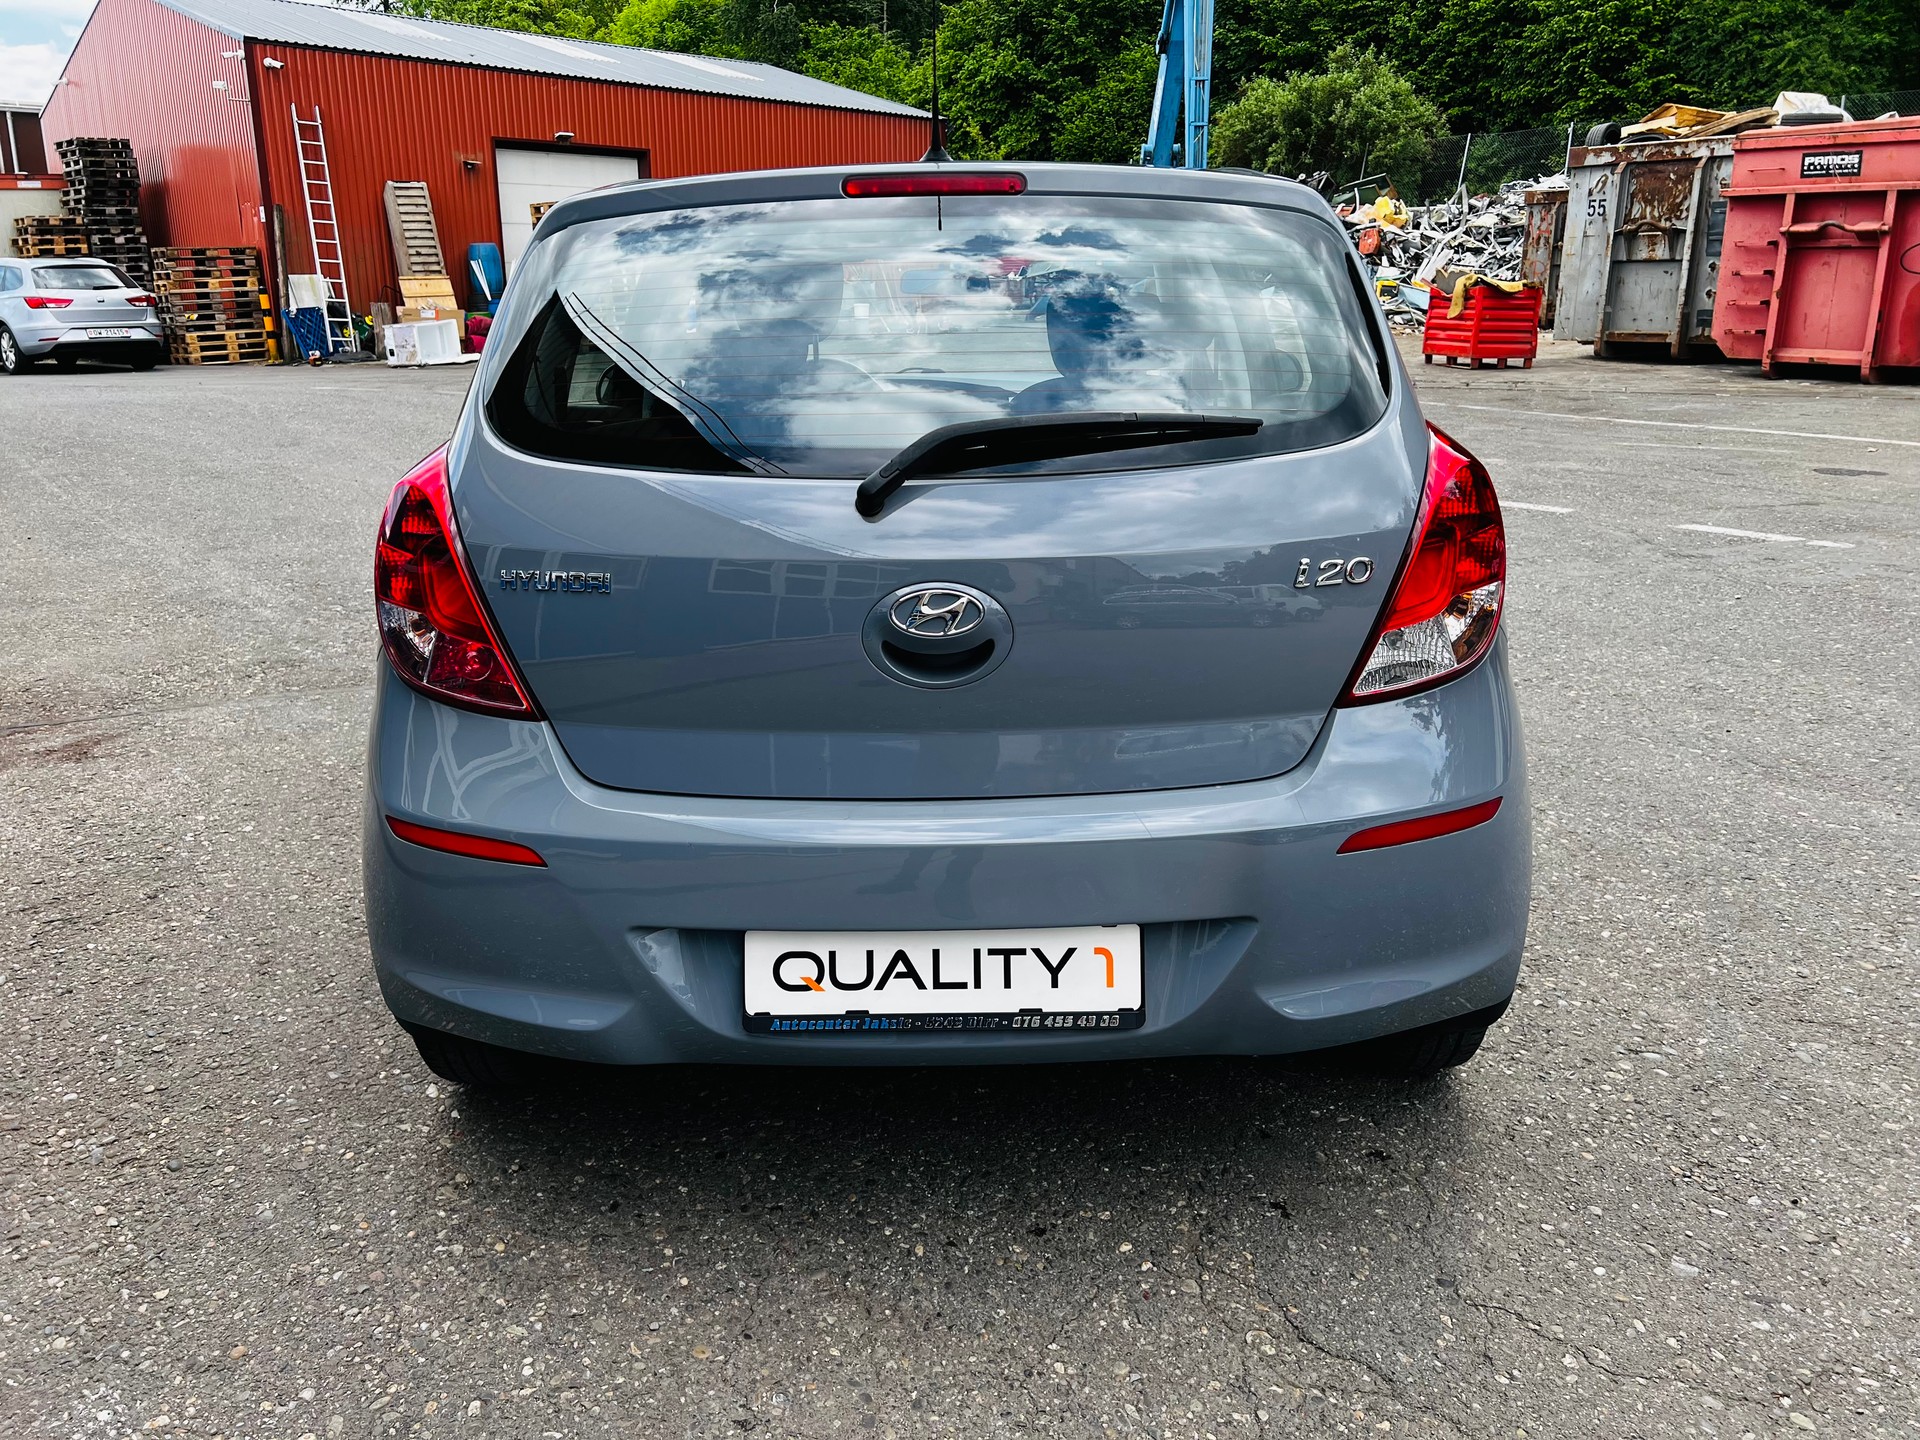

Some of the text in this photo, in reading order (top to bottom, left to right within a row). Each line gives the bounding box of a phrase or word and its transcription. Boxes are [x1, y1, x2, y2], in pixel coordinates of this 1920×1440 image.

[1804, 154, 1859, 165] PAMOS
[1587, 198, 1606, 217] 55
[500, 569, 611, 592] HYUNDAI
[772, 947, 1114, 992] QUALITY 1
[770, 1018, 859, 1030] Autocenter
[1012, 1016, 1040, 1028] 076
